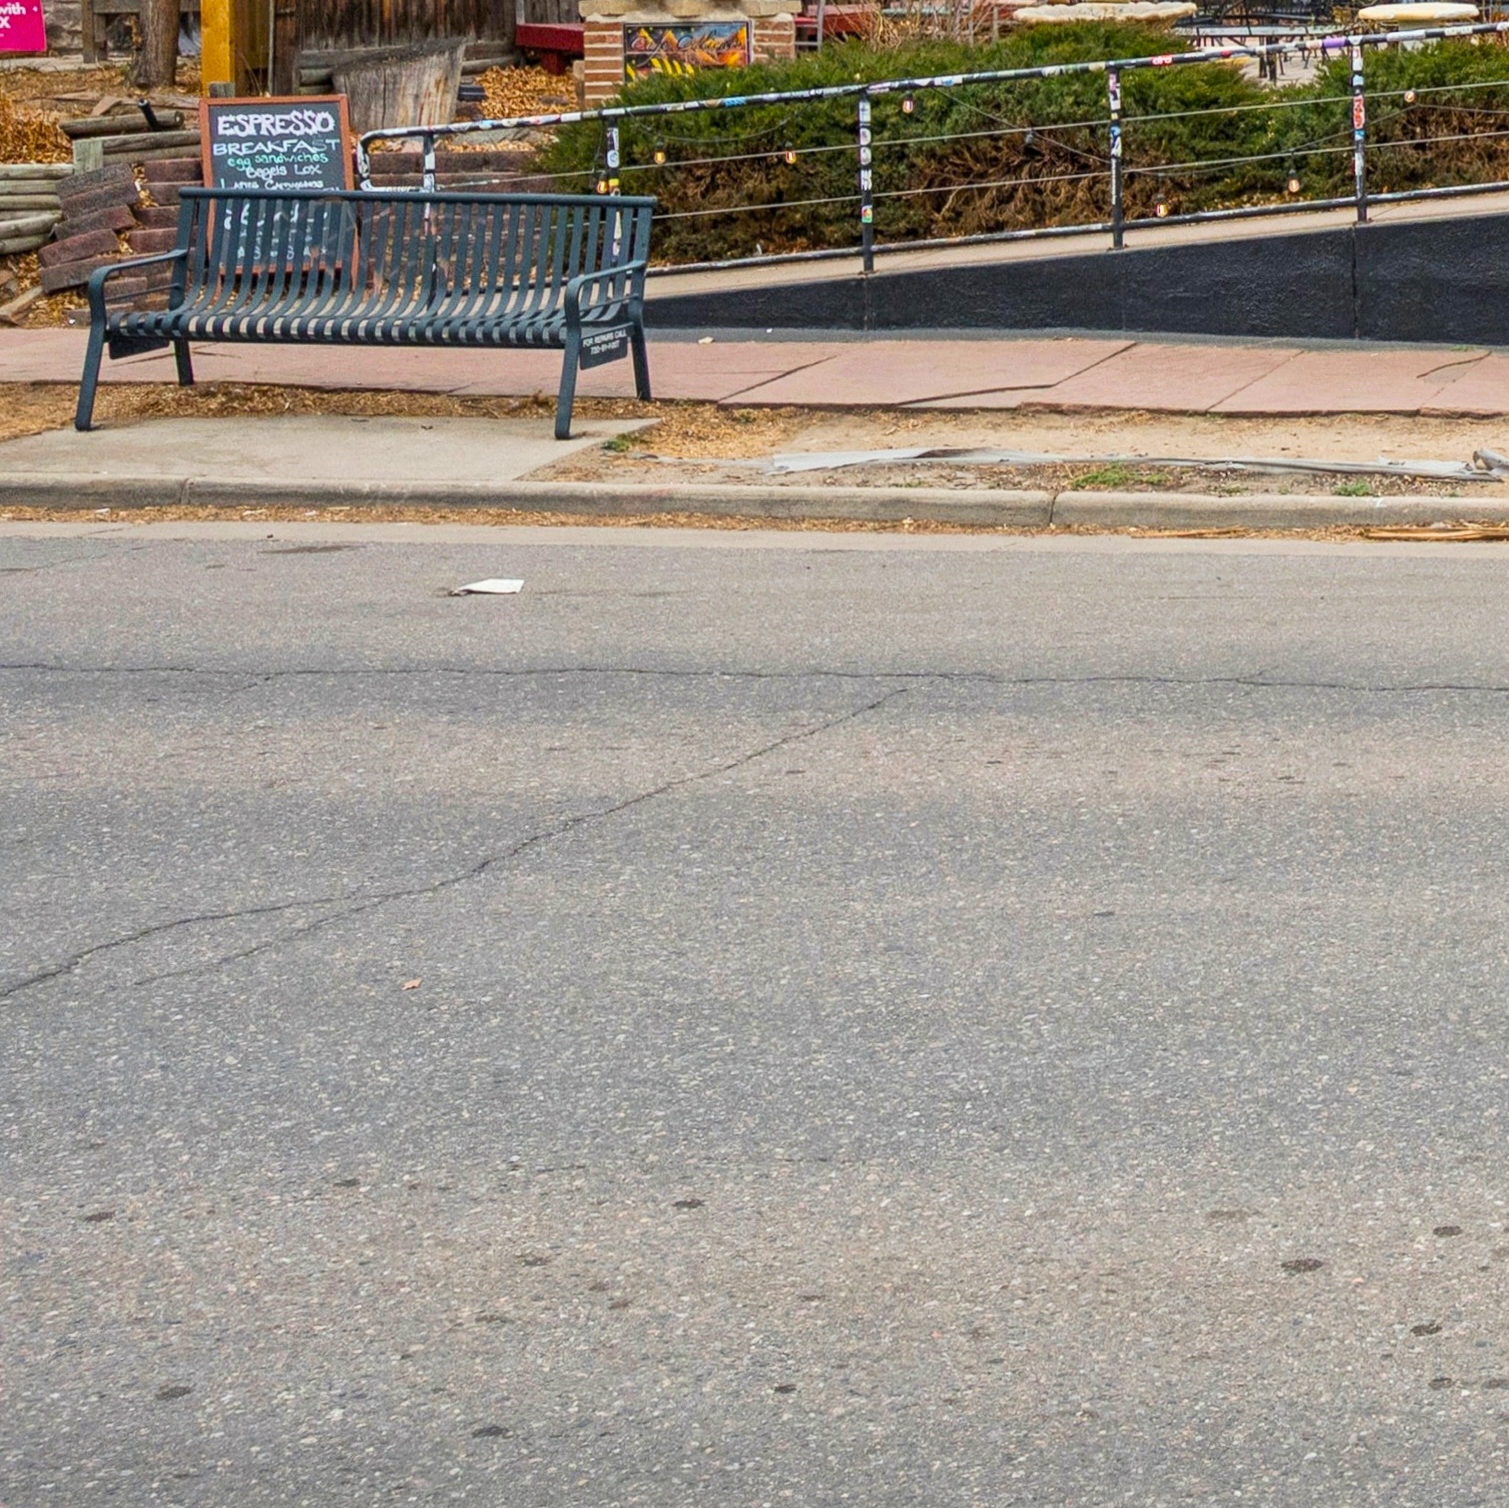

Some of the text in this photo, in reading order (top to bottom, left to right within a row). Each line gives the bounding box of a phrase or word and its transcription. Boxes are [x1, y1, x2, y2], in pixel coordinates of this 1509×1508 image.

[217, 110, 335, 137] ESPRESSO
[213, 139, 340, 156] BREAKFAST
[227, 152, 329, 172] egg sandwiches
